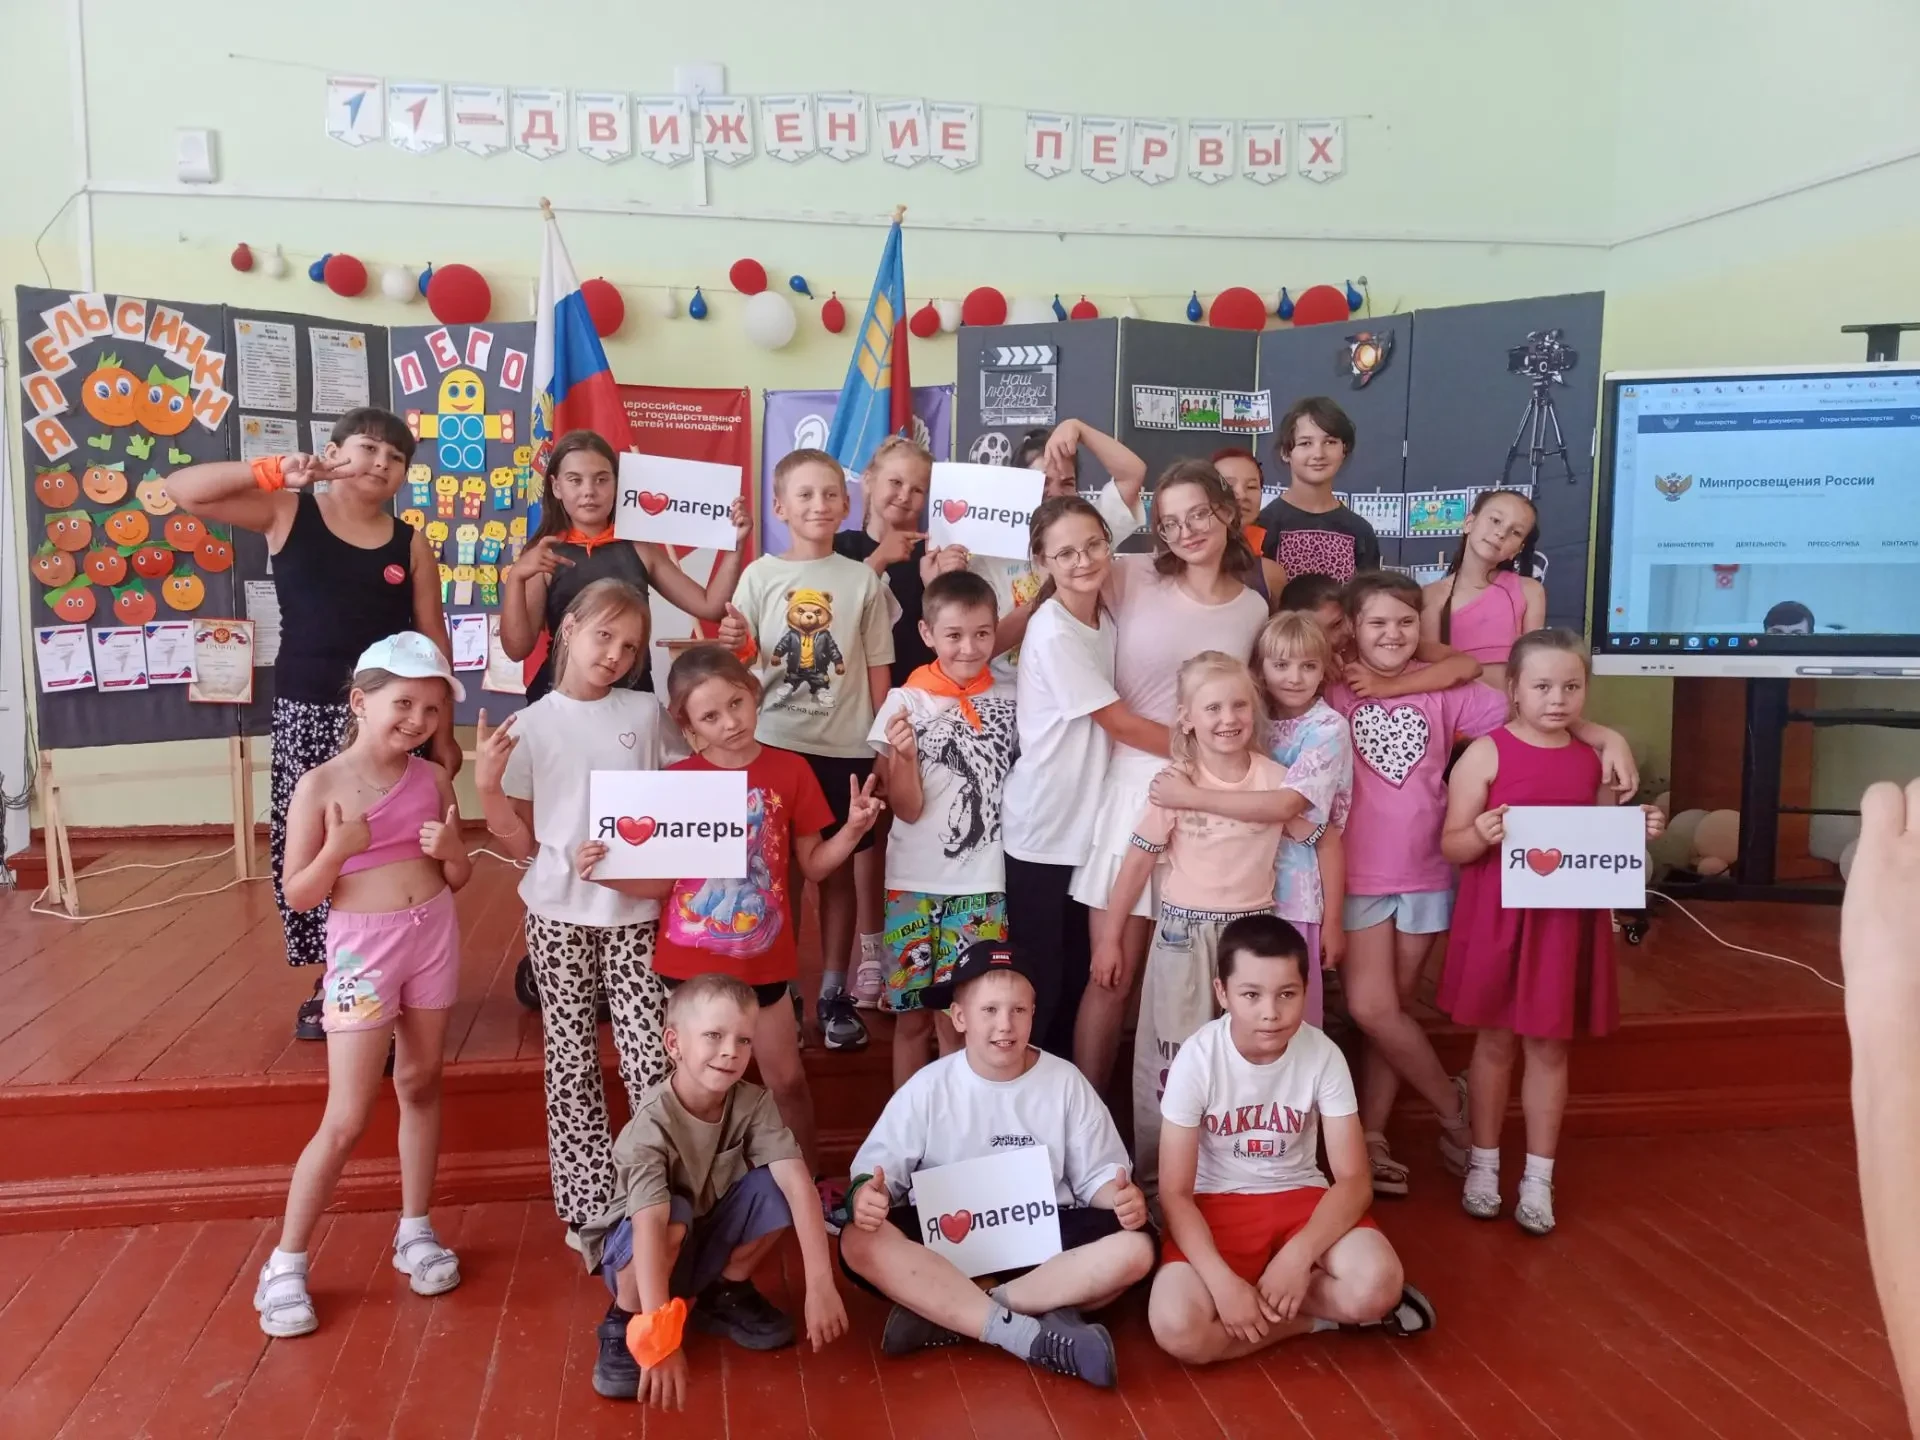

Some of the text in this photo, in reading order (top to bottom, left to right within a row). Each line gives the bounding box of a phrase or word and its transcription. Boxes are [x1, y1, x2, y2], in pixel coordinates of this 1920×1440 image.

[521, 109, 1334, 166] ДВИЖЕНИЕ ПЕРВЫХ
[402, 330, 523, 392] ЛЕГО
[29, 298, 230, 455] АПЕЛЬСИНКИ
[630, 420, 664, 428] детей
[675, 422, 733, 432] молодёжи
[1699, 475, 1875, 490] Минпросвещения России
[623, 489, 638, 508] Я
[932, 499, 942, 517] Я
[598, 816, 744, 843] Я лагерь
[1509, 848, 1642, 874] Я лагерь
[1188, 910, 1207, 920] LOVE
[1207, 912, 1226, 921] LOVE
[1204, 1102, 1306, 1137] OAKLAN
[927, 1199, 1055, 1243] Я лагерь
